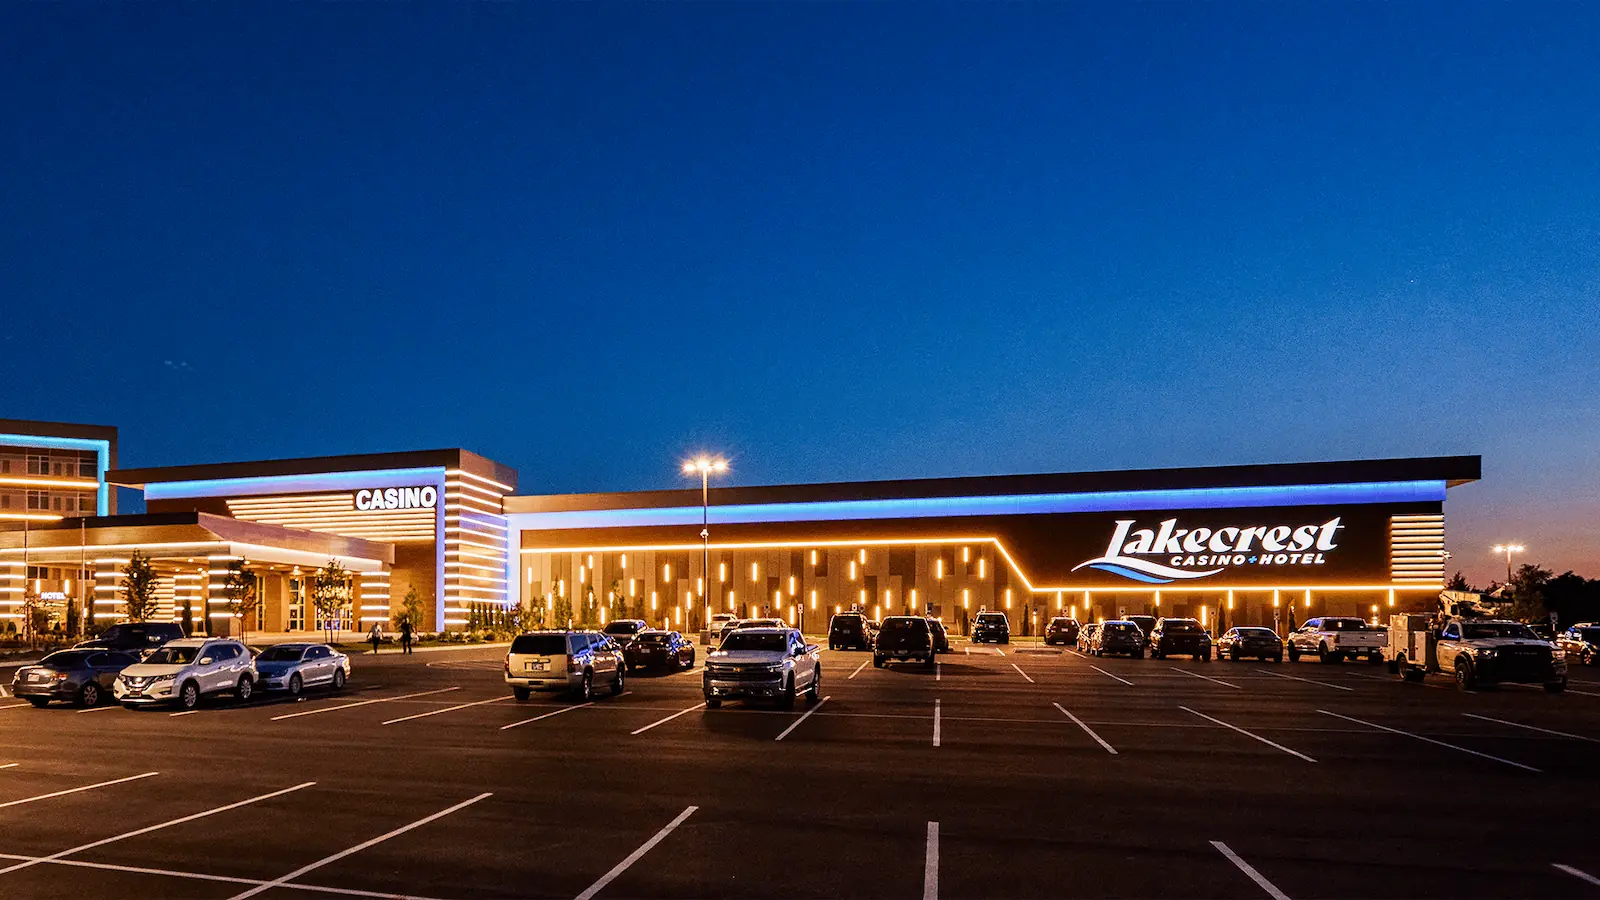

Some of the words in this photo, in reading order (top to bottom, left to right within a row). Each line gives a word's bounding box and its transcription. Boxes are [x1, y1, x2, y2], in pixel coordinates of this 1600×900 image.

[355, 486, 438, 511] CASINO
[1104, 516, 1346, 559] Lakecrest
[40, 591, 66, 600] HOTEL
